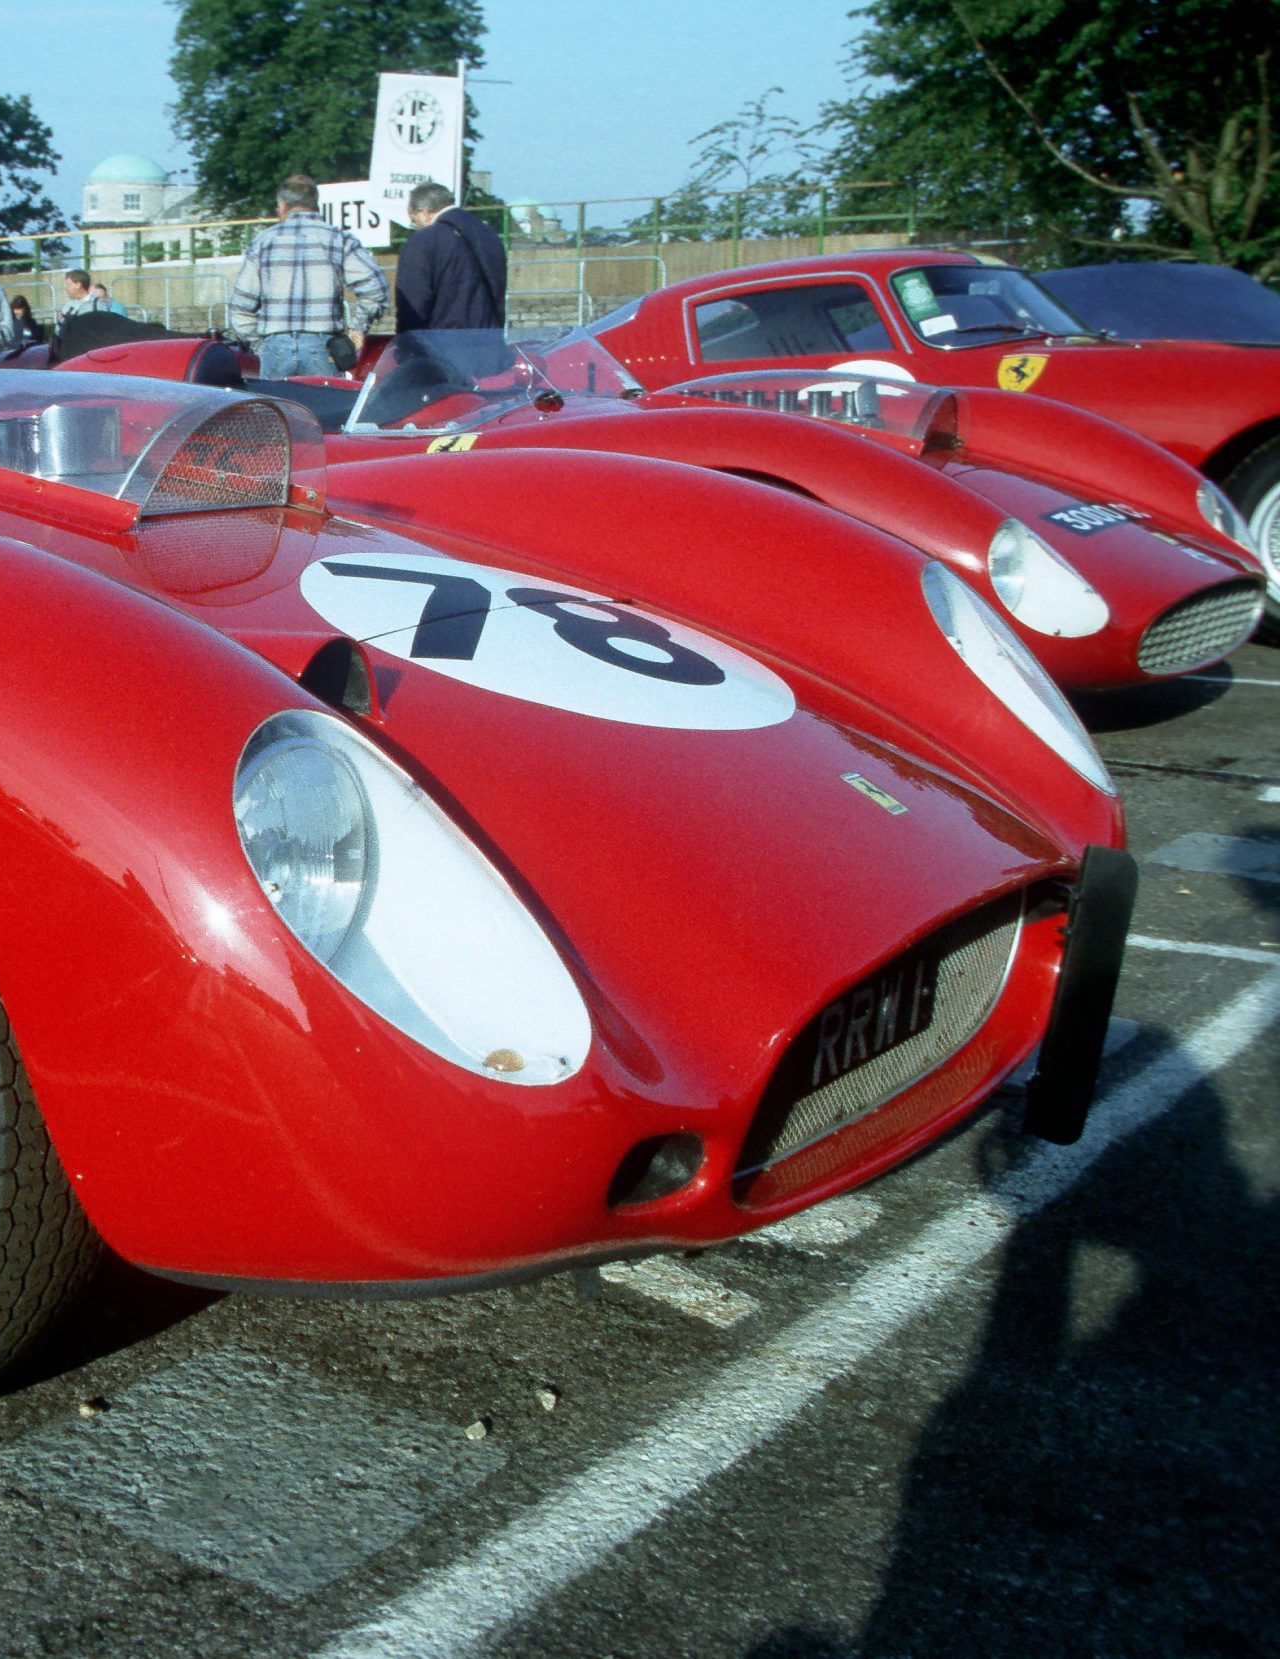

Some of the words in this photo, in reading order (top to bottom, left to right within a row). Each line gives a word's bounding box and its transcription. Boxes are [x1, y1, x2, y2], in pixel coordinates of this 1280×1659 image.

[383, 188, 404, 199] ALFA
[1050, 504, 1127, 531] 3000
[319, 561, 726, 686] 78
